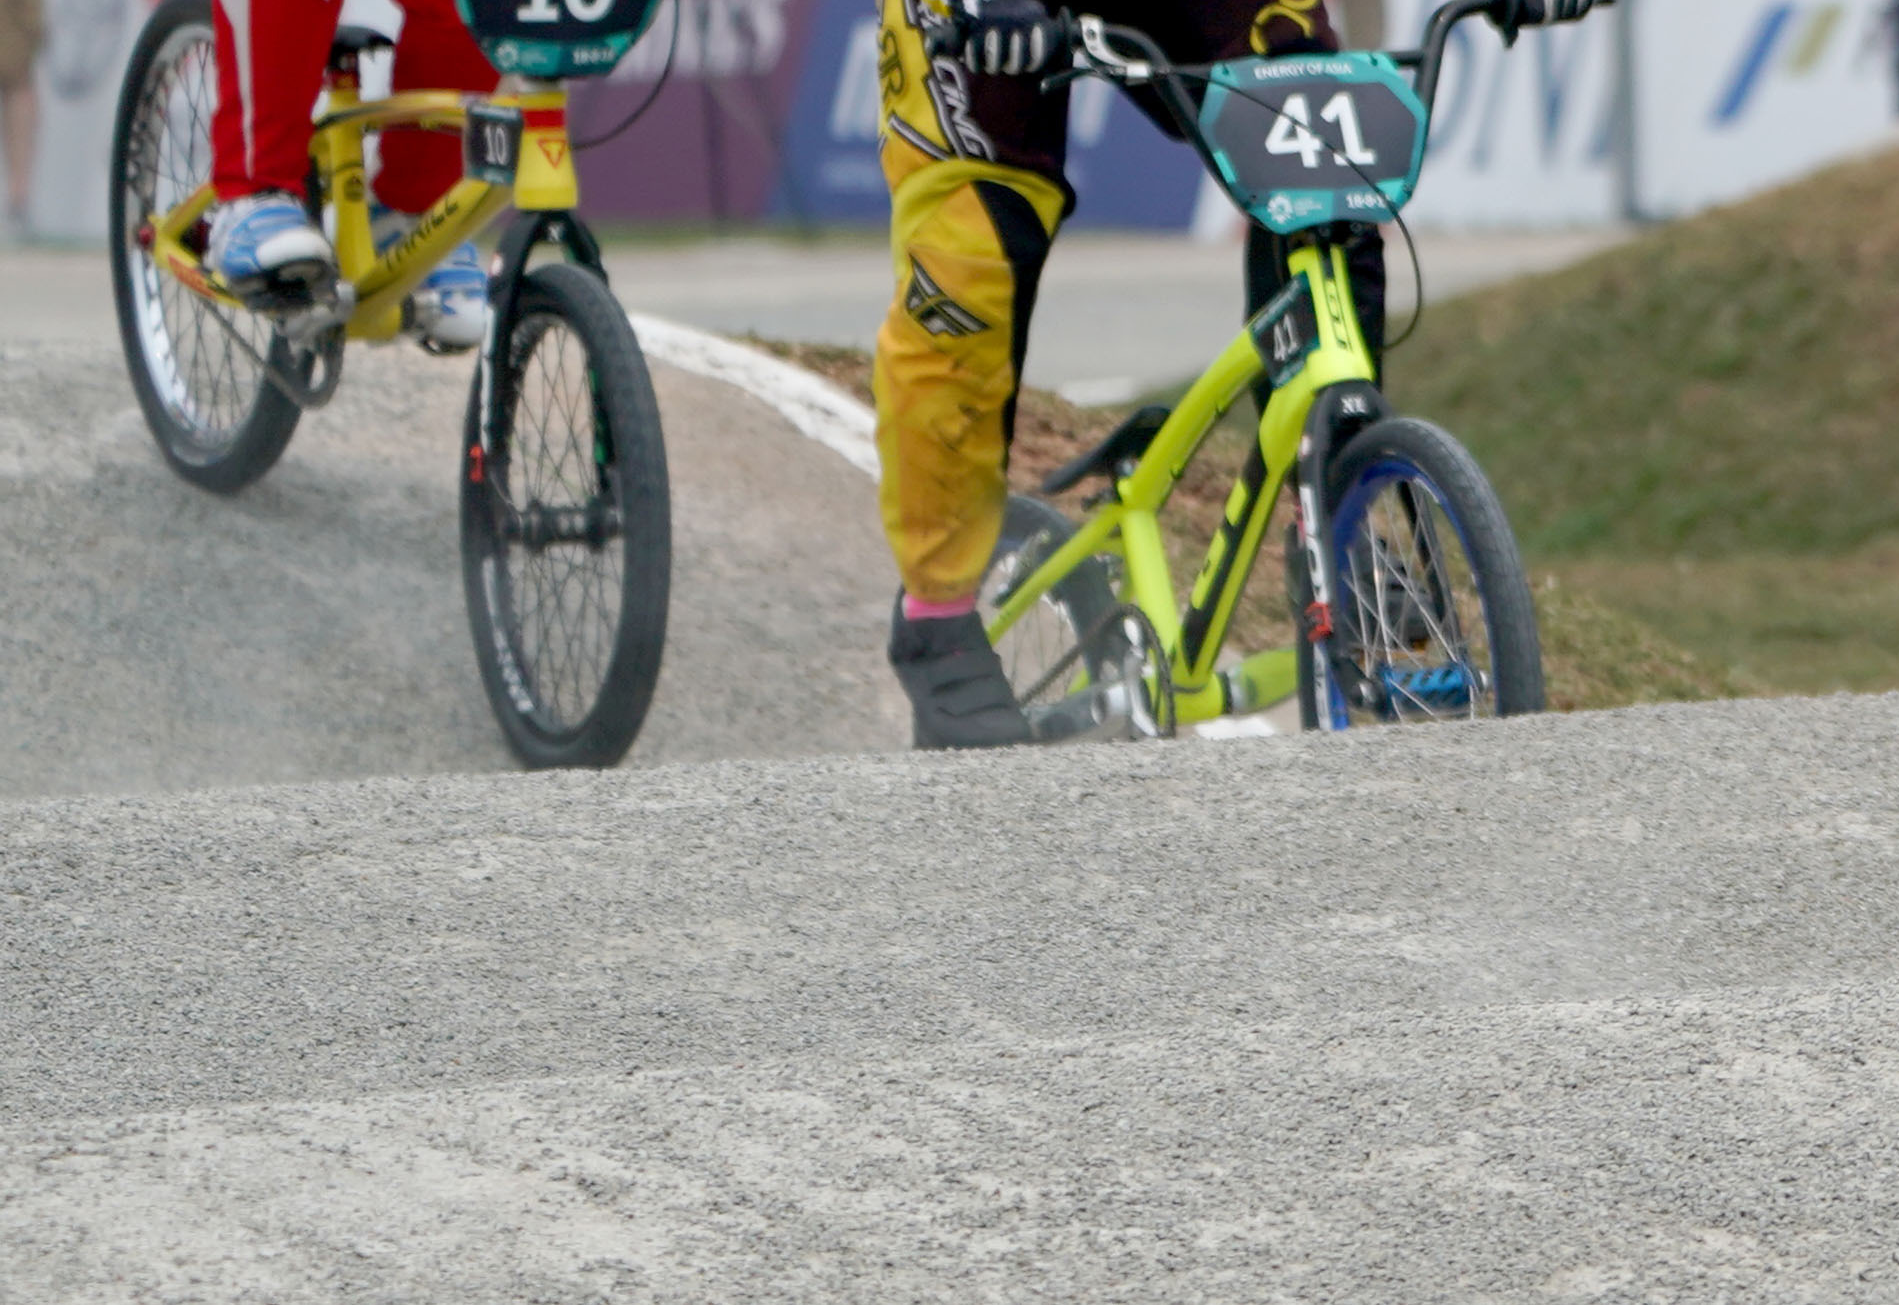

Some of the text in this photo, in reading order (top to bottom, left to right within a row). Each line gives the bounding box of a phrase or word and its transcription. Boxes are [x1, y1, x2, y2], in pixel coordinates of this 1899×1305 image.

[1254, 61, 1352, 80] ENERGY OF ASIA
[483, 126, 508, 166] 10
[1264, 92, 1377, 168] 41
[1273, 314, 1298, 361] 41
